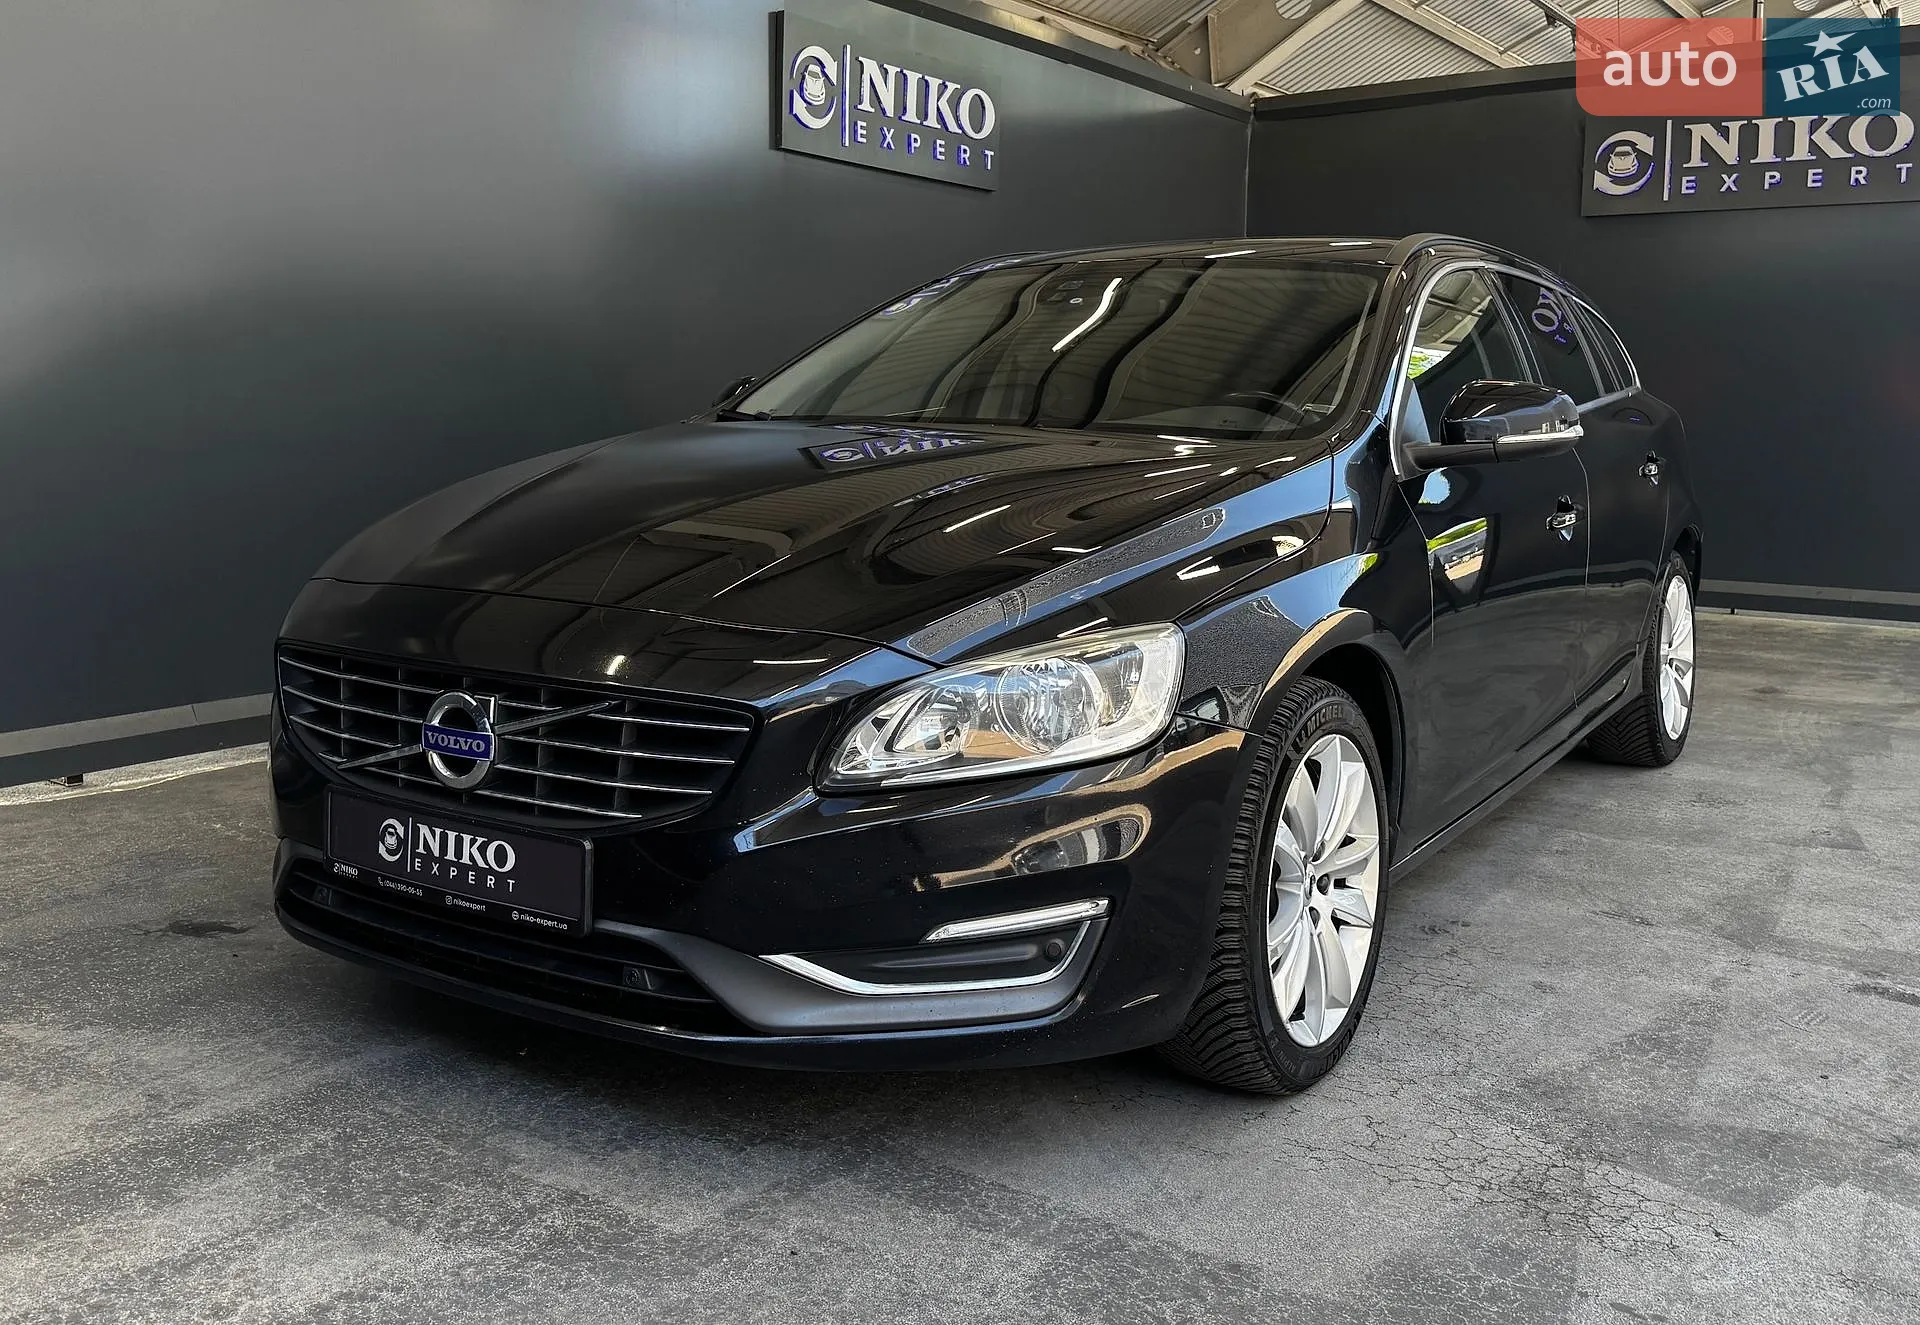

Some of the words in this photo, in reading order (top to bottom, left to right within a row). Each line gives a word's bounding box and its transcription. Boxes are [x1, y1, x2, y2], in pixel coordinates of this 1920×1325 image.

[854, 56, 996, 140] NIKO
[854, 121, 995, 170] EXPERT
[1683, 109, 1915, 168] NIKO
[1680, 163, 1913, 194] EXPERT
[425, 731, 485, 752] VOLVO
[415, 823, 516, 872] NIKO
[340, 864, 358, 876] NIKO
[414, 859, 516, 892] EXPERT
[520, 913, 568, 930] niko-expert.ua
